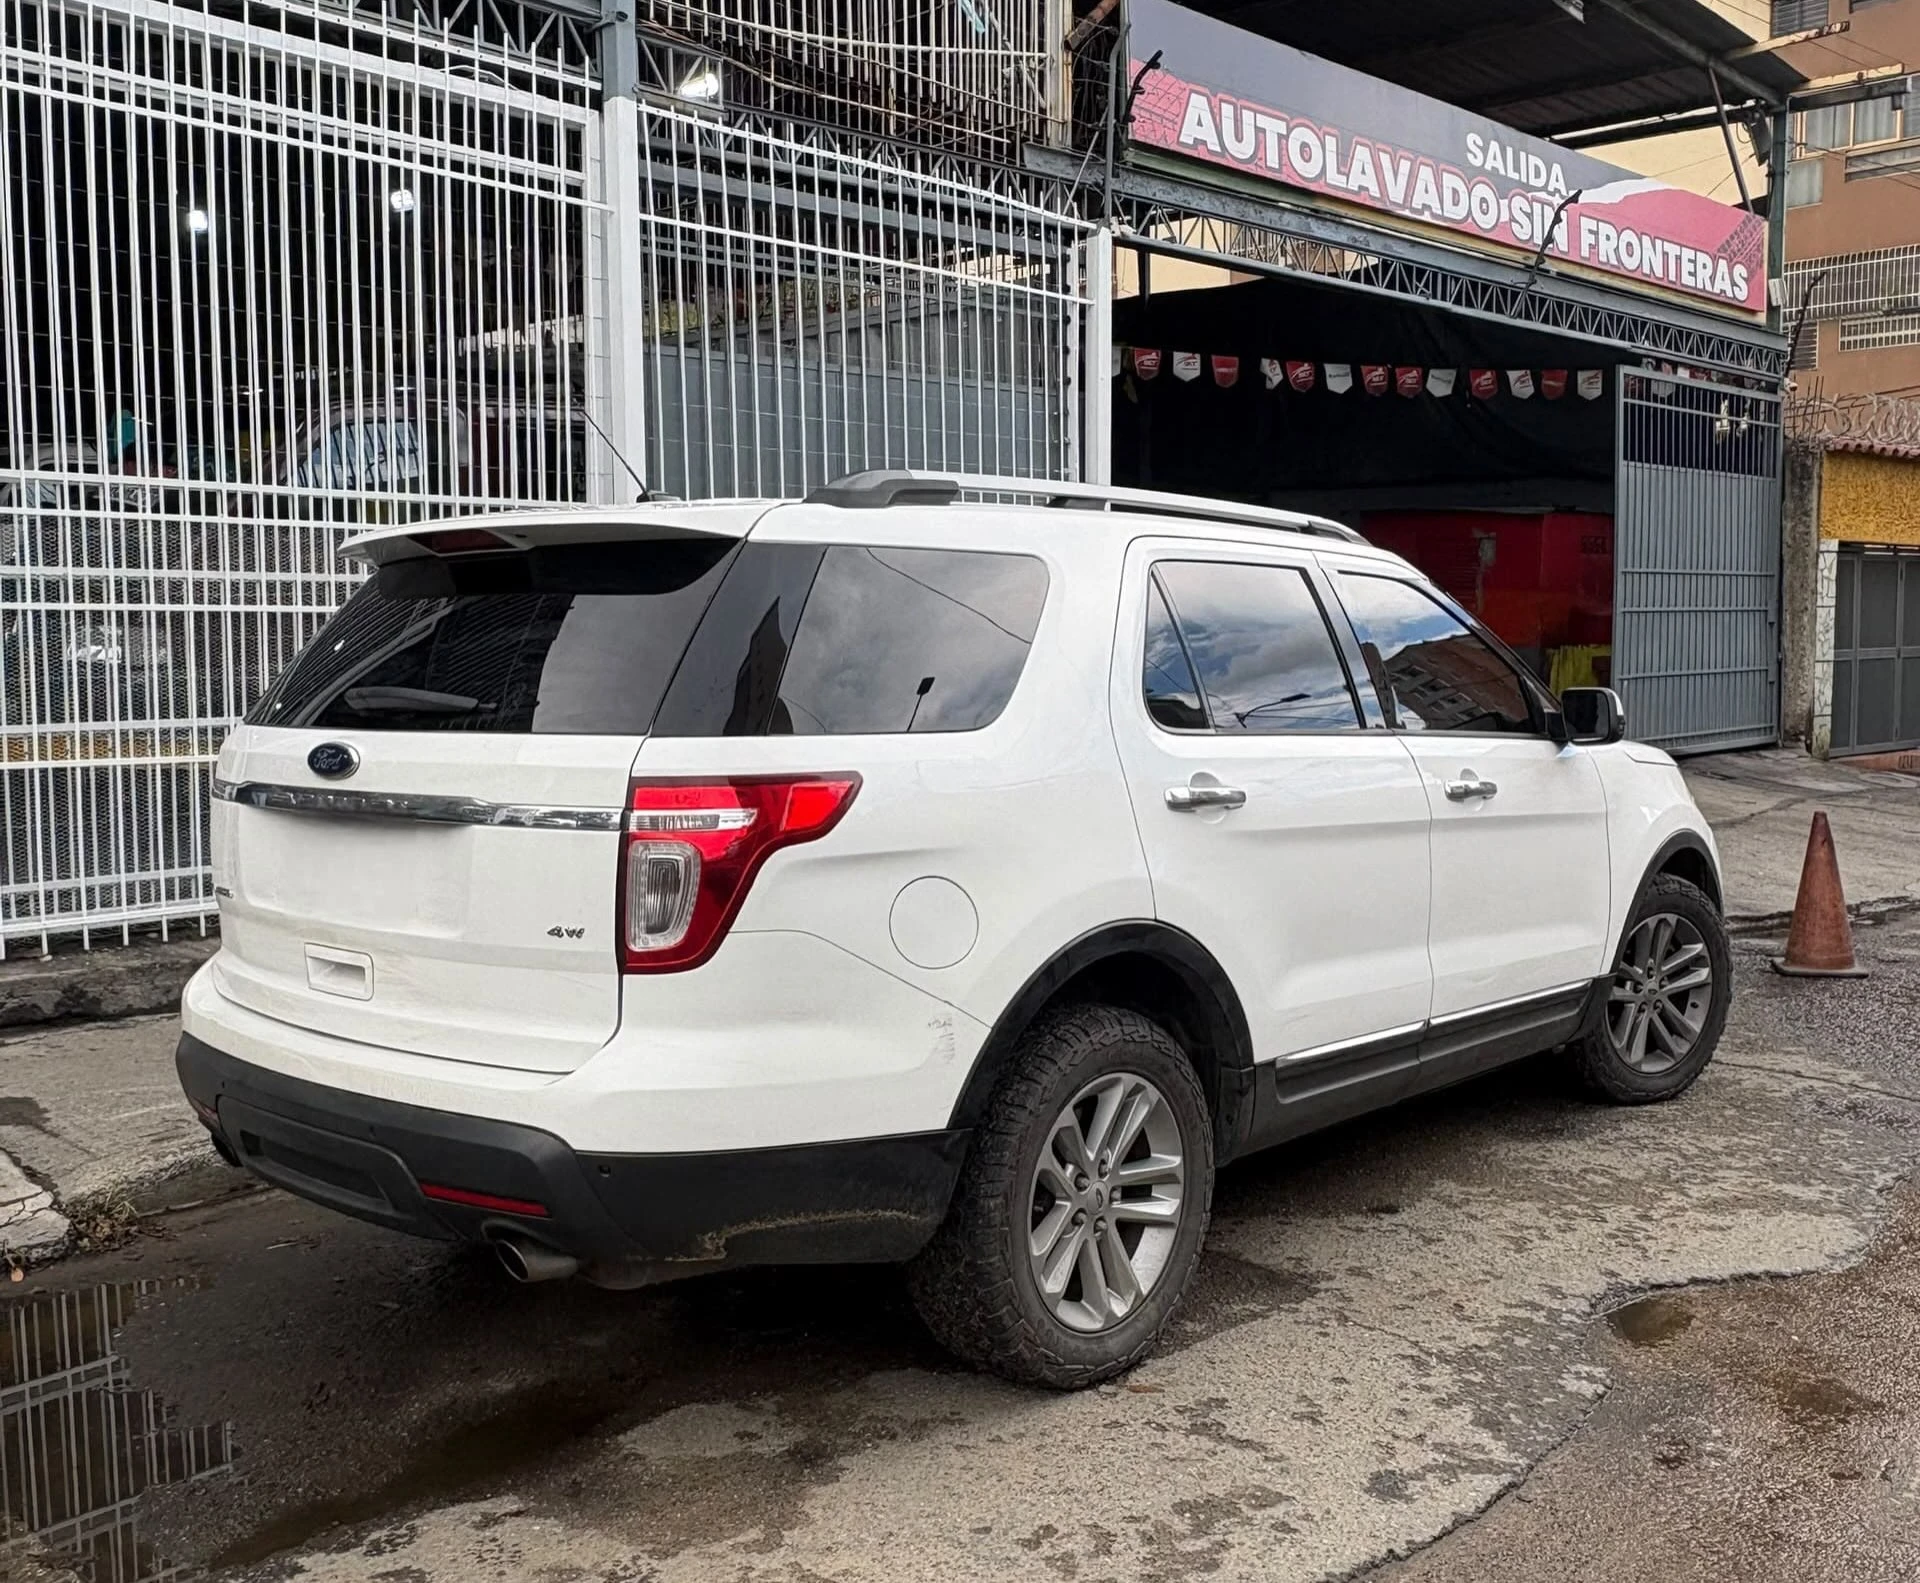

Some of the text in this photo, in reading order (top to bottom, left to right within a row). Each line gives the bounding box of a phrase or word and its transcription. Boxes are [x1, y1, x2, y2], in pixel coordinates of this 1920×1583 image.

[1179, 92, 1749, 302] AUTOLAVADO SIN FRONTERAS
[1466, 132, 1568, 196] SALIDA
